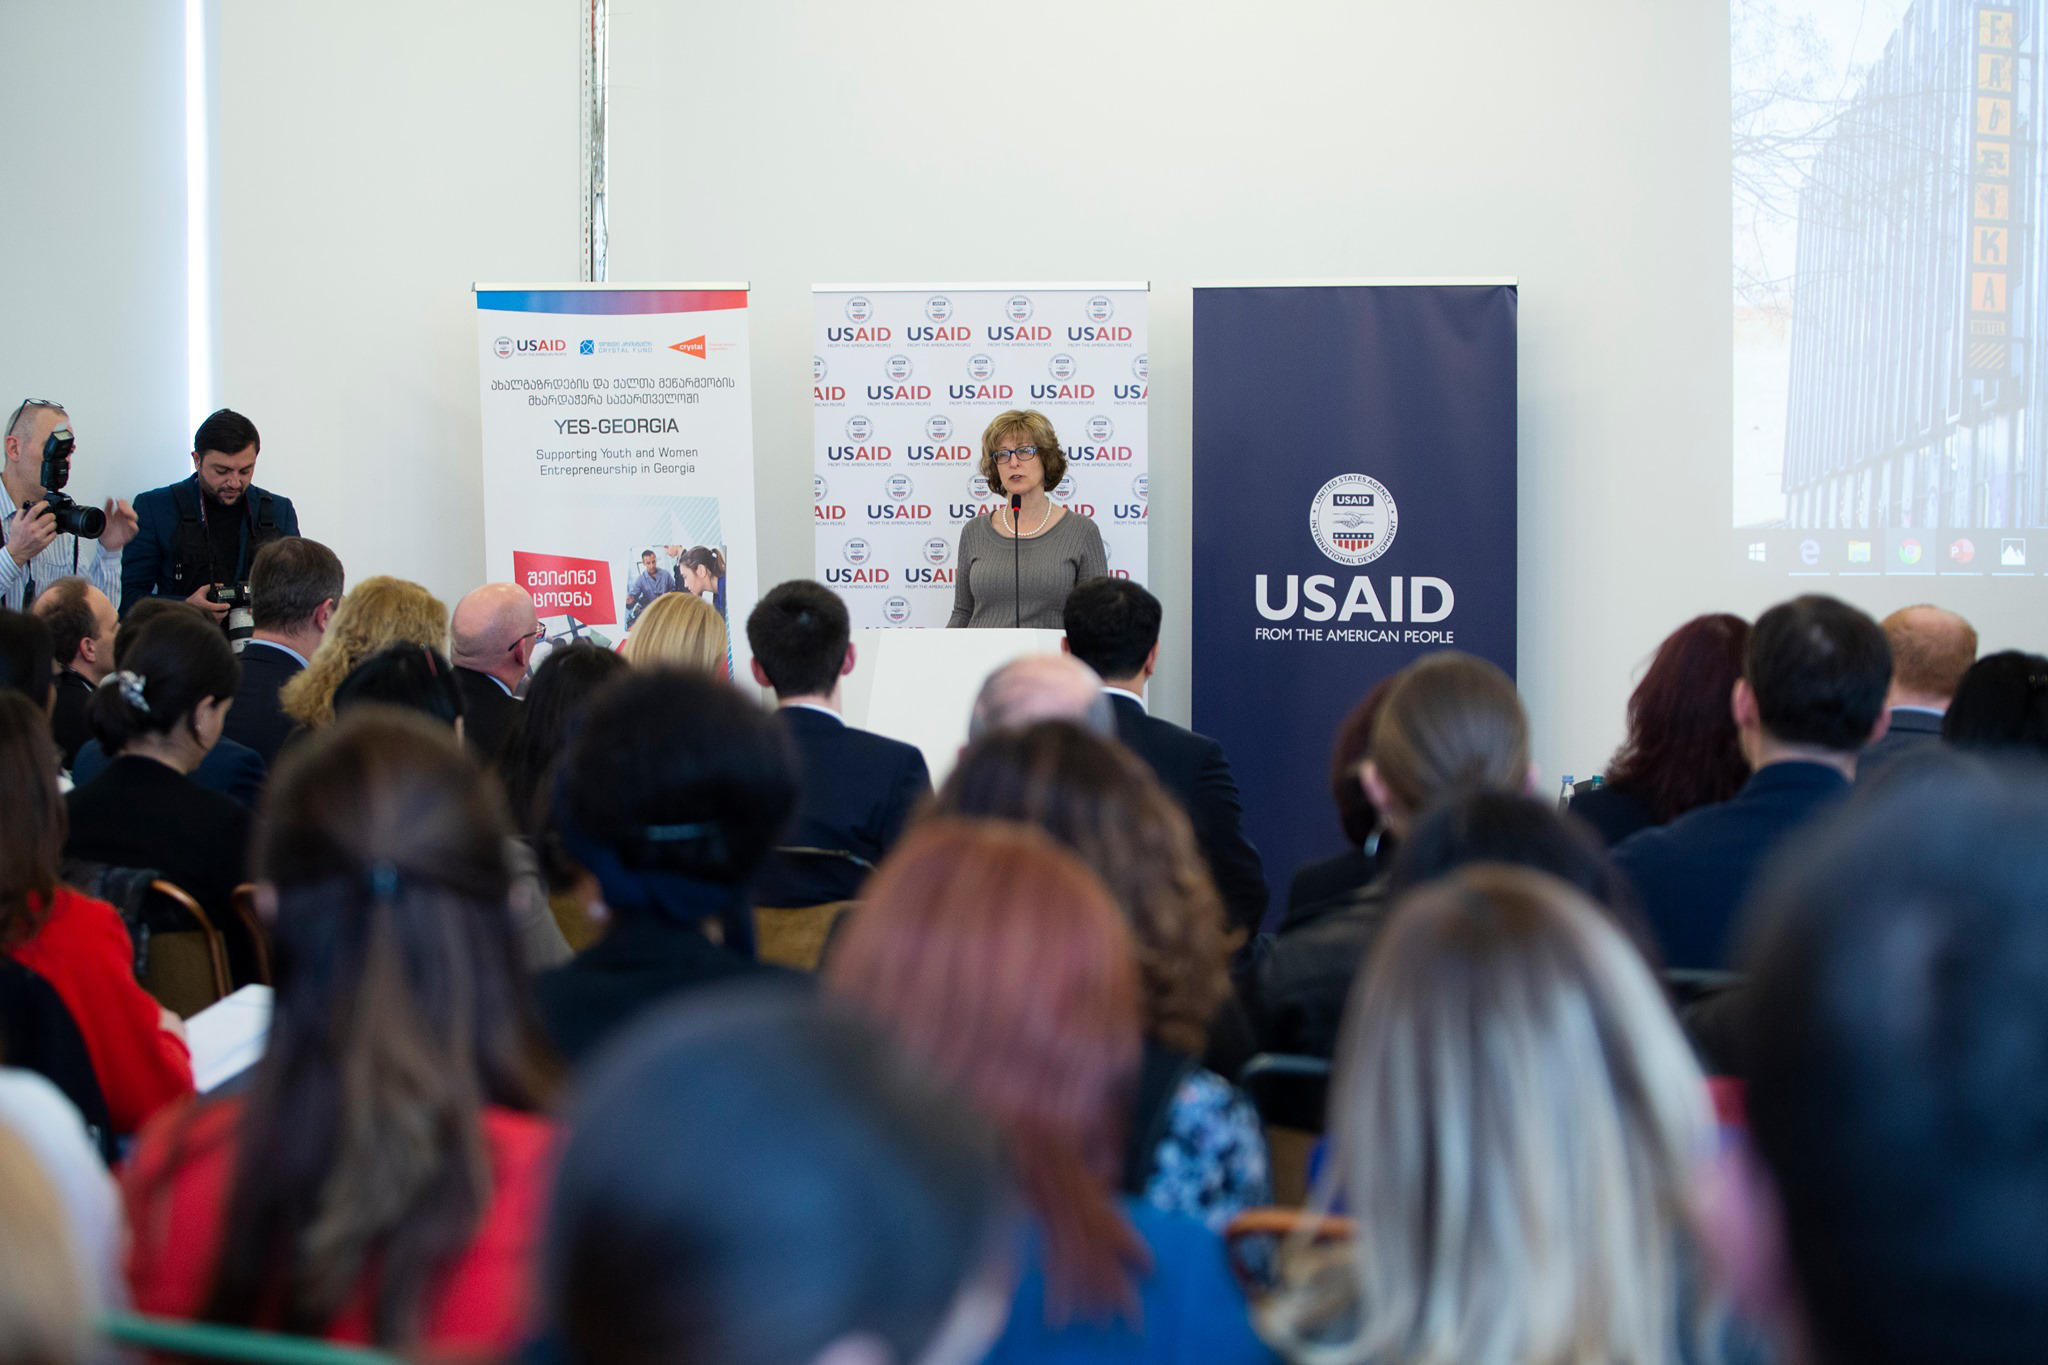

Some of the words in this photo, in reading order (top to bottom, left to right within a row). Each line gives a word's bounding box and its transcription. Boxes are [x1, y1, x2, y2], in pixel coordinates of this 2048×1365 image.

[828, 328, 891, 341] USAID
[908, 327, 971, 341] USAID
[988, 327, 1052, 340] USAID
[1068, 327, 1132, 341] USAID
[517, 340, 566, 351] USAID
[594, 378, 609, 389] და
[607, 393, 699, 404] საქართველოში
[814, 386, 846, 400] AID
[868, 386, 931, 400] USAID
[950, 385, 1013, 399] USAID
[1031, 385, 1094, 399] USAID
[554, 418, 679, 434] YES-GEORGIA
[536, 449, 597, 461] Supporting
[601, 448, 631, 458] Youth
[636, 448, 654, 458] and
[659, 448, 698, 457] Women
[828, 446, 891, 460] USAID
[908, 446, 971, 460] USAID
[1068, 447, 1132, 460] USAID
[540, 464, 637, 476] Entrepreneurship
[642, 464, 650, 473] in
[654, 463, 695, 475] Georgia
[1315, 480, 1337, 504] UNITED
[1338, 475, 1366, 483] STATES
[1367, 478, 1393, 505] AGENCY
[1337, 496, 1369, 504] USAID
[815, 505, 846, 519] AID
[867, 505, 931, 519] USAID
[950, 504, 1006, 518] USA
[1312, 520, 1355, 564] INTERNATIONAL
[1358, 520, 1396, 564] DEVELOPMENT
[528, 570, 596, 586] შეიძინე
[826, 569, 889, 582] USAID
[906, 568, 958, 582] USAI
[533, 592, 592, 607] ცოდნა
[1256, 574, 1454, 622] USAID
[1255, 628, 1292, 640] FROM
[1296, 628, 1323, 641] THE
[1326, 630, 1400, 642] AMERICAN
[1405, 630, 1454, 644] PEOPLE
